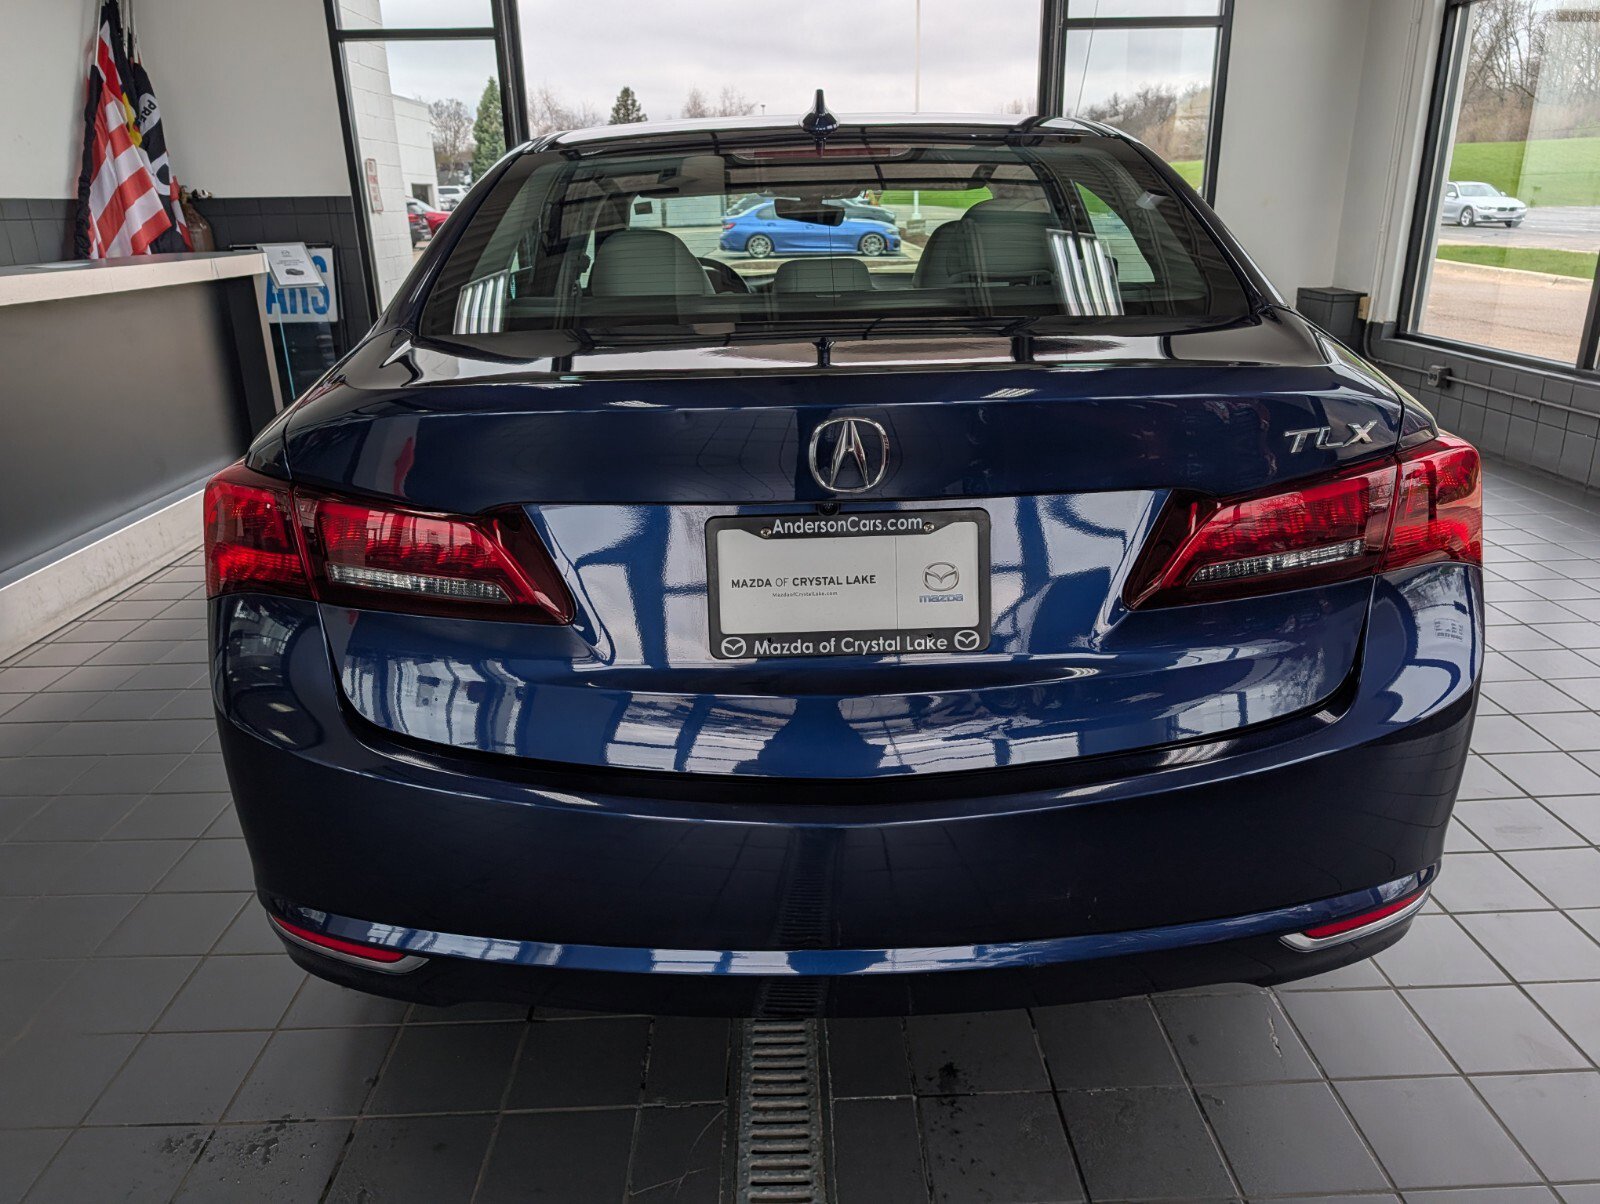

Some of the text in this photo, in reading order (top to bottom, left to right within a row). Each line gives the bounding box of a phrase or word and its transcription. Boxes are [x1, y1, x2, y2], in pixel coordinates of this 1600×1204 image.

[1283, 420, 1377, 453] TLX
[772, 517, 923, 534] AndersonCars.com
[731, 575, 876, 588] MAZDA OF CRYSTAL LAKE
[753, 634, 948, 655] Mazda of Crystal Lake
